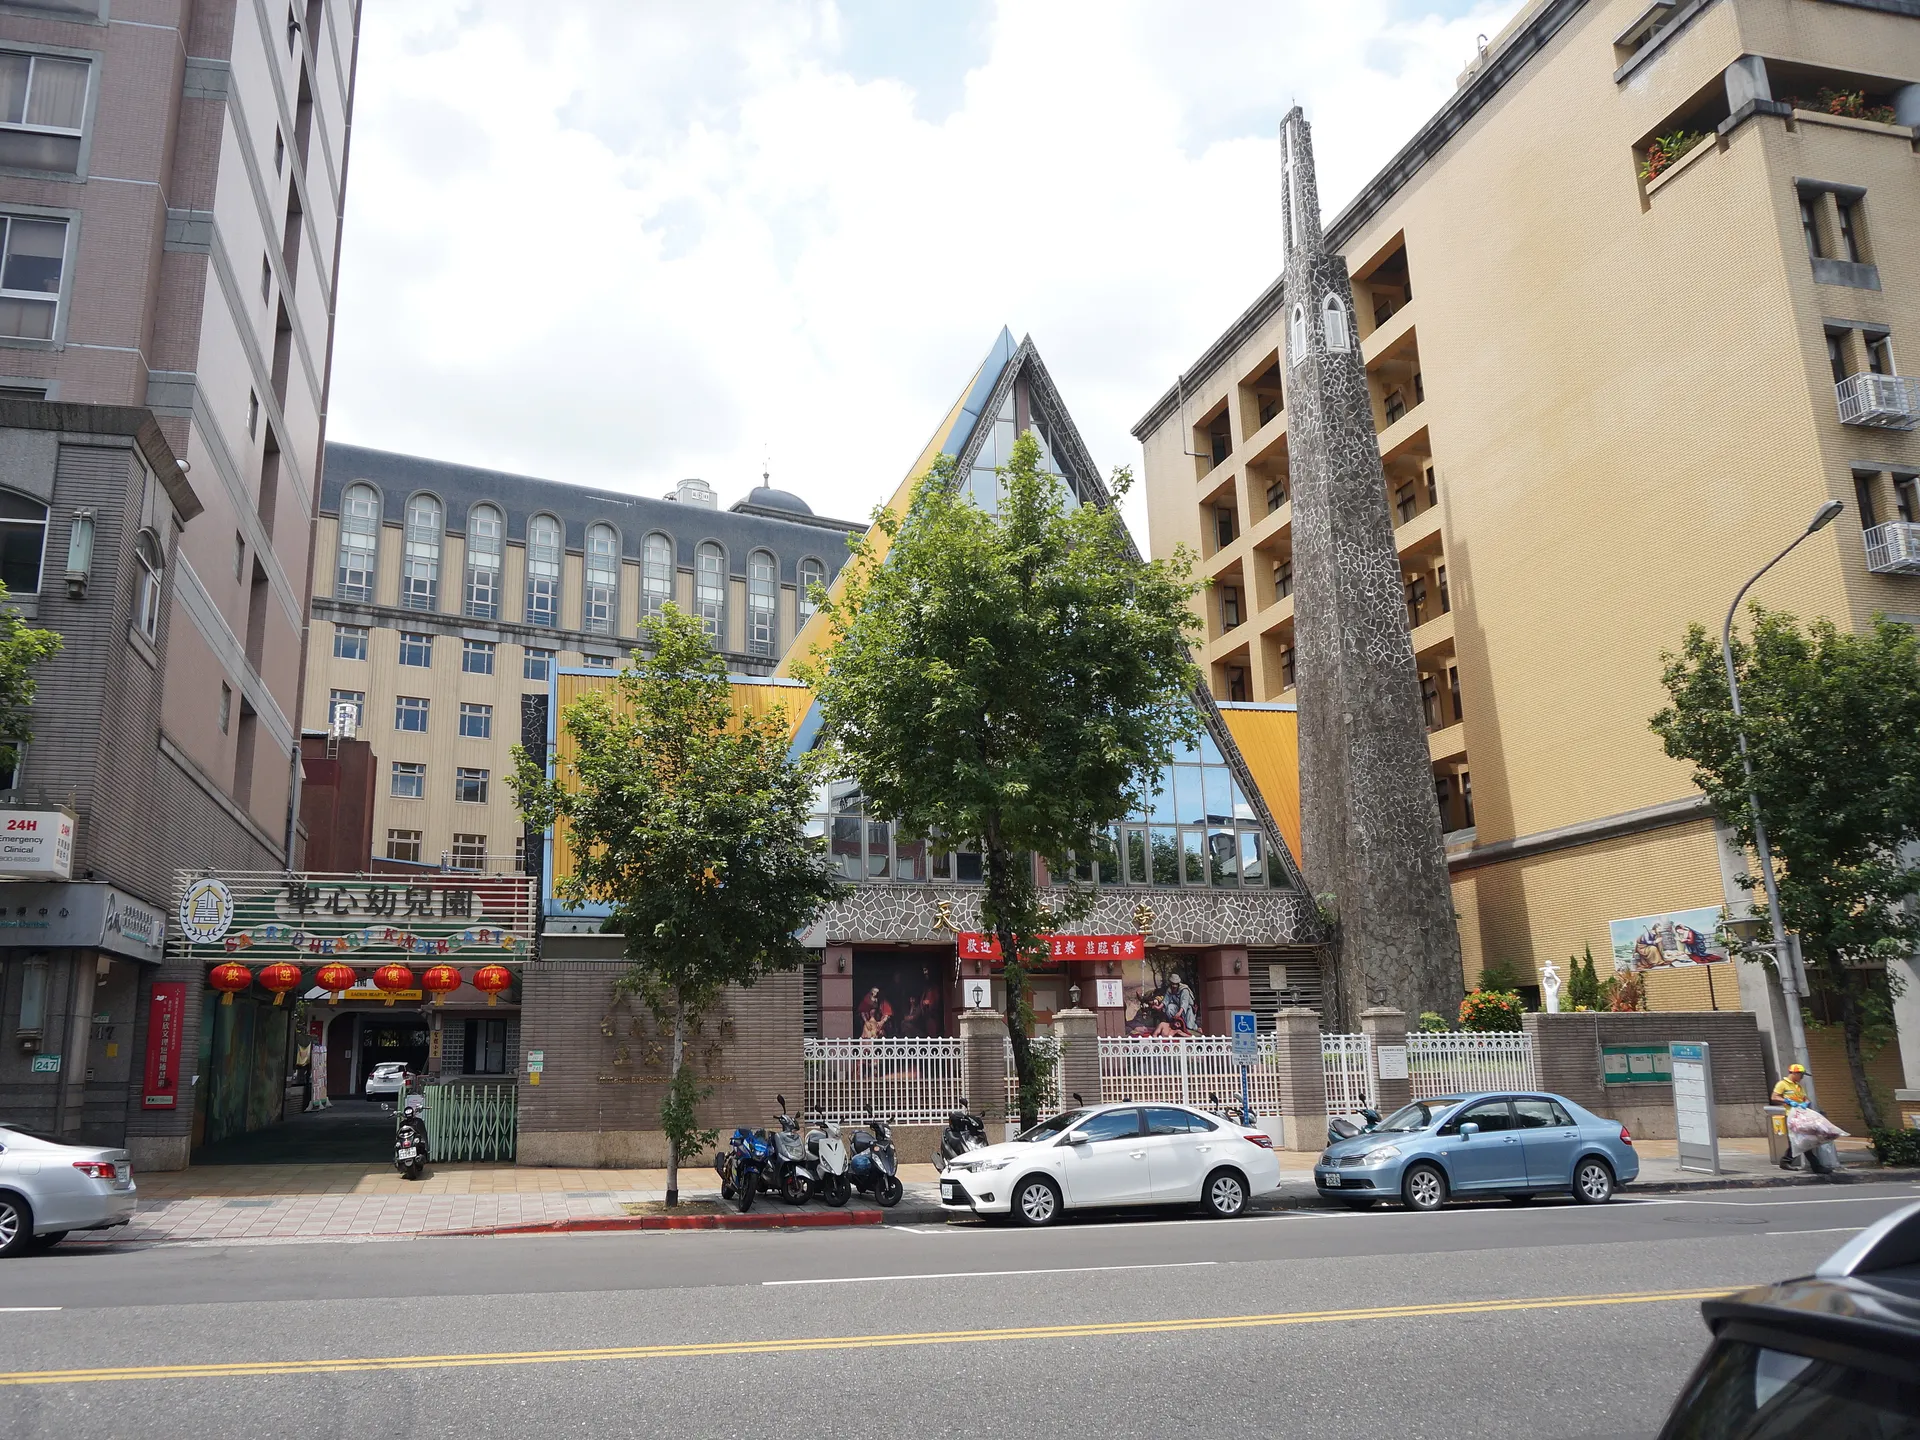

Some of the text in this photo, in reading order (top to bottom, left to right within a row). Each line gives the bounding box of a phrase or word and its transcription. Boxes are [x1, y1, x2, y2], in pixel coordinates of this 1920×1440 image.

[7, 819, 38, 831] 24H
[3, 845, 34, 854] Clinical
[286, 884, 473, 918] 聖心幼兒園
[225, 925, 528, 955] SACRED HEART KINDERGARTEN
[36, 1061, 57, 1070] 247
